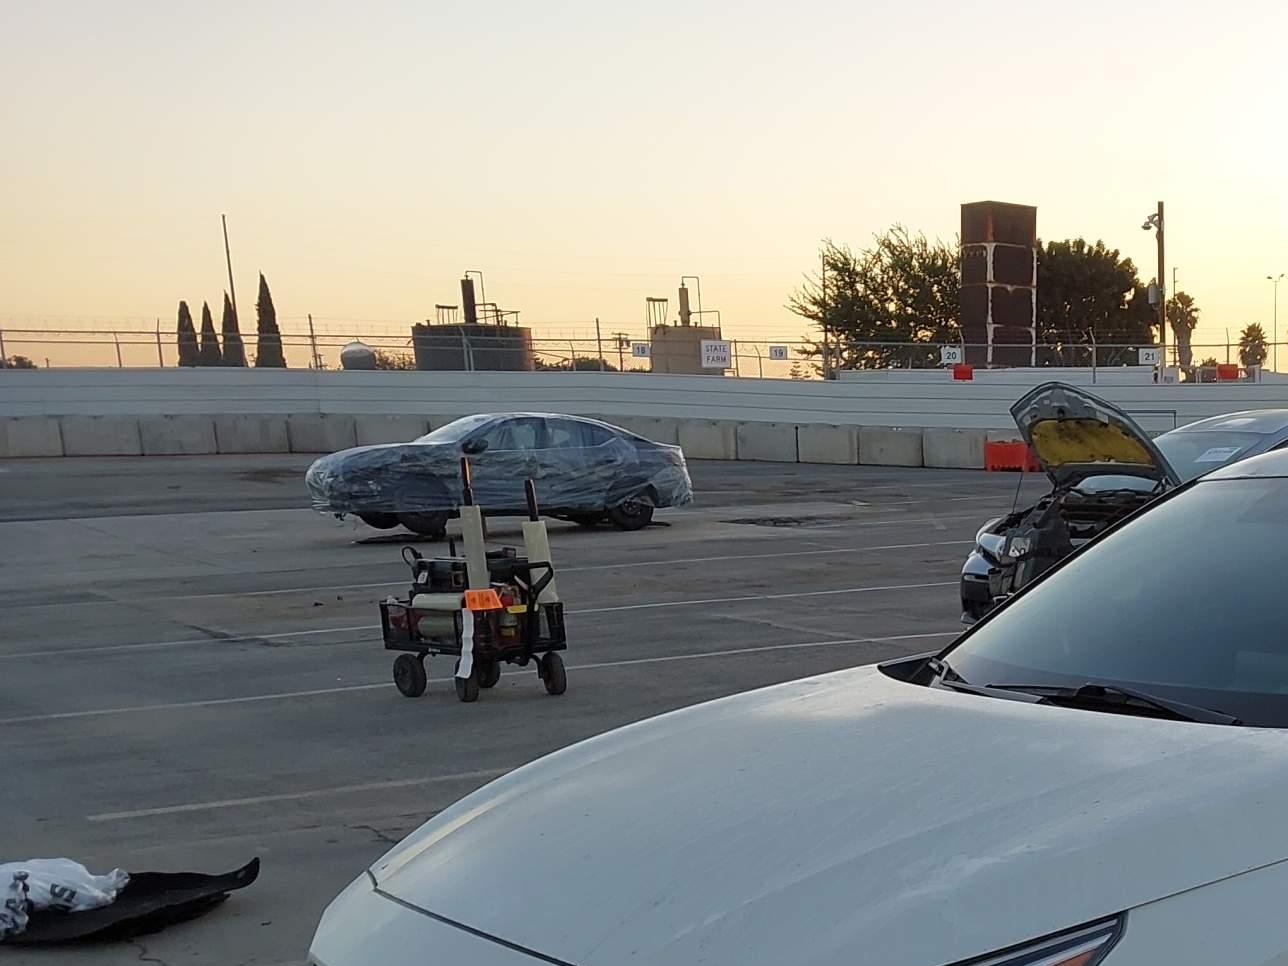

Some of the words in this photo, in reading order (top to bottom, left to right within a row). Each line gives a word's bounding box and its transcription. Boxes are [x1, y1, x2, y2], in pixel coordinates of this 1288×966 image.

[636, 345, 646, 354] 18
[705, 344, 727, 353] STATE
[773, 349, 784, 358] 19
[946, 351, 957, 360] 20
[1144, 352, 1155, 361] 21
[705, 356, 727, 364] FARM
